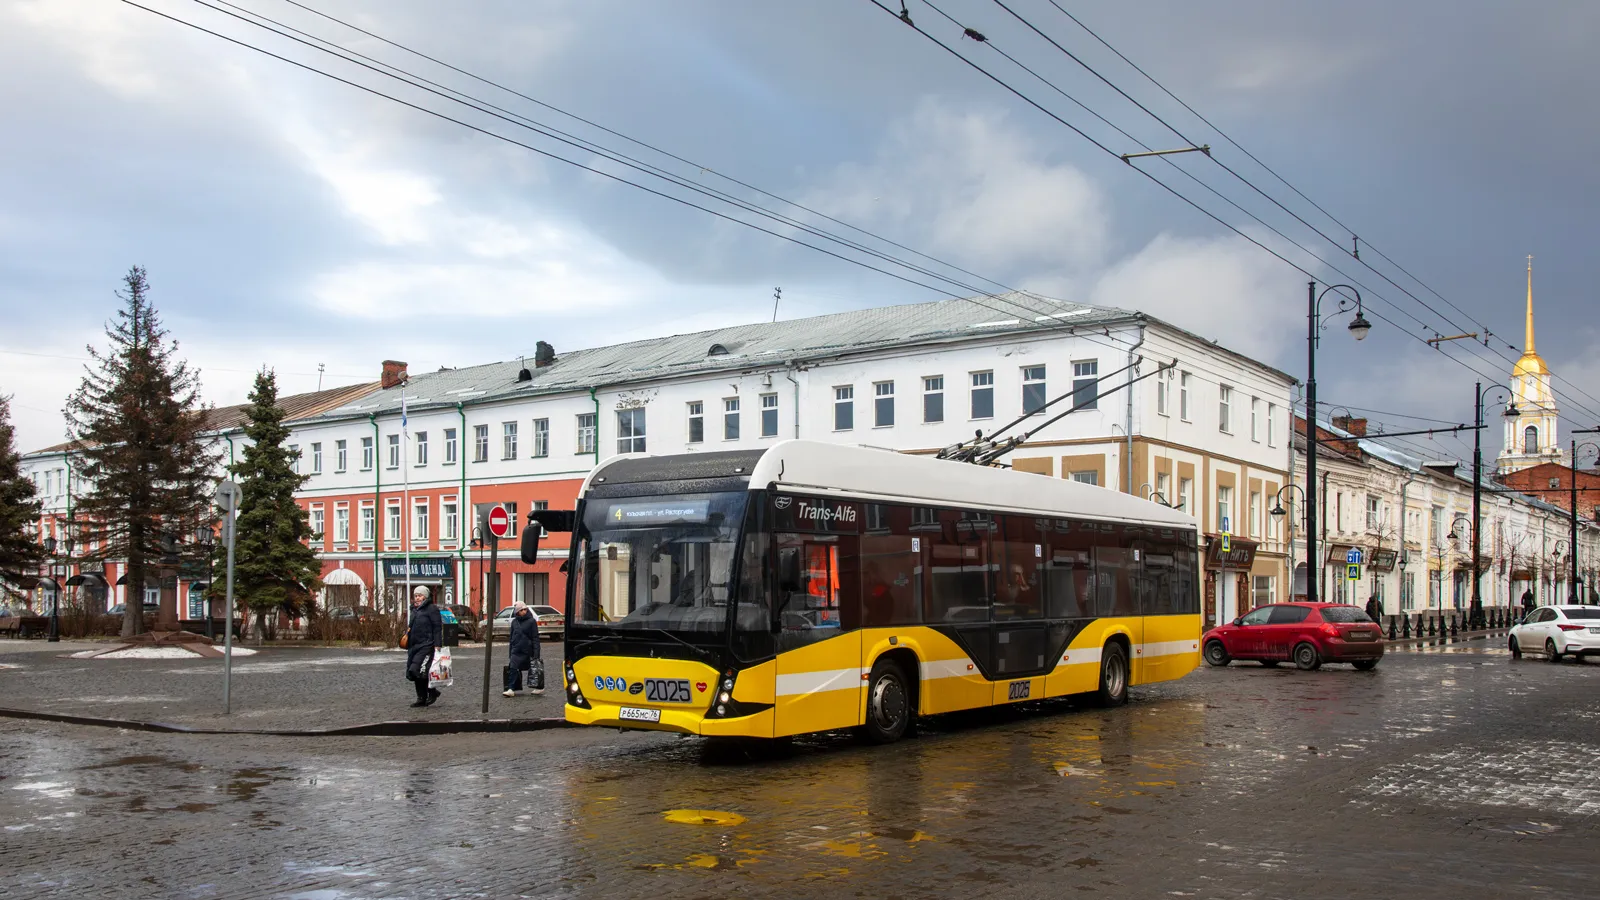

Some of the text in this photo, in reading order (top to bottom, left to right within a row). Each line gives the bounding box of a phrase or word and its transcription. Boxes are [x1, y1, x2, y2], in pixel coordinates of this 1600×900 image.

[615, 508, 622, 521] 4
[798, 502, 857, 522] Trans-Alfa
[391, 564, 446, 576] МУЖСАЯ ОДЕЖДА
[645, 680, 691, 702] 2025
[1009, 681, 1030, 700] 2025
